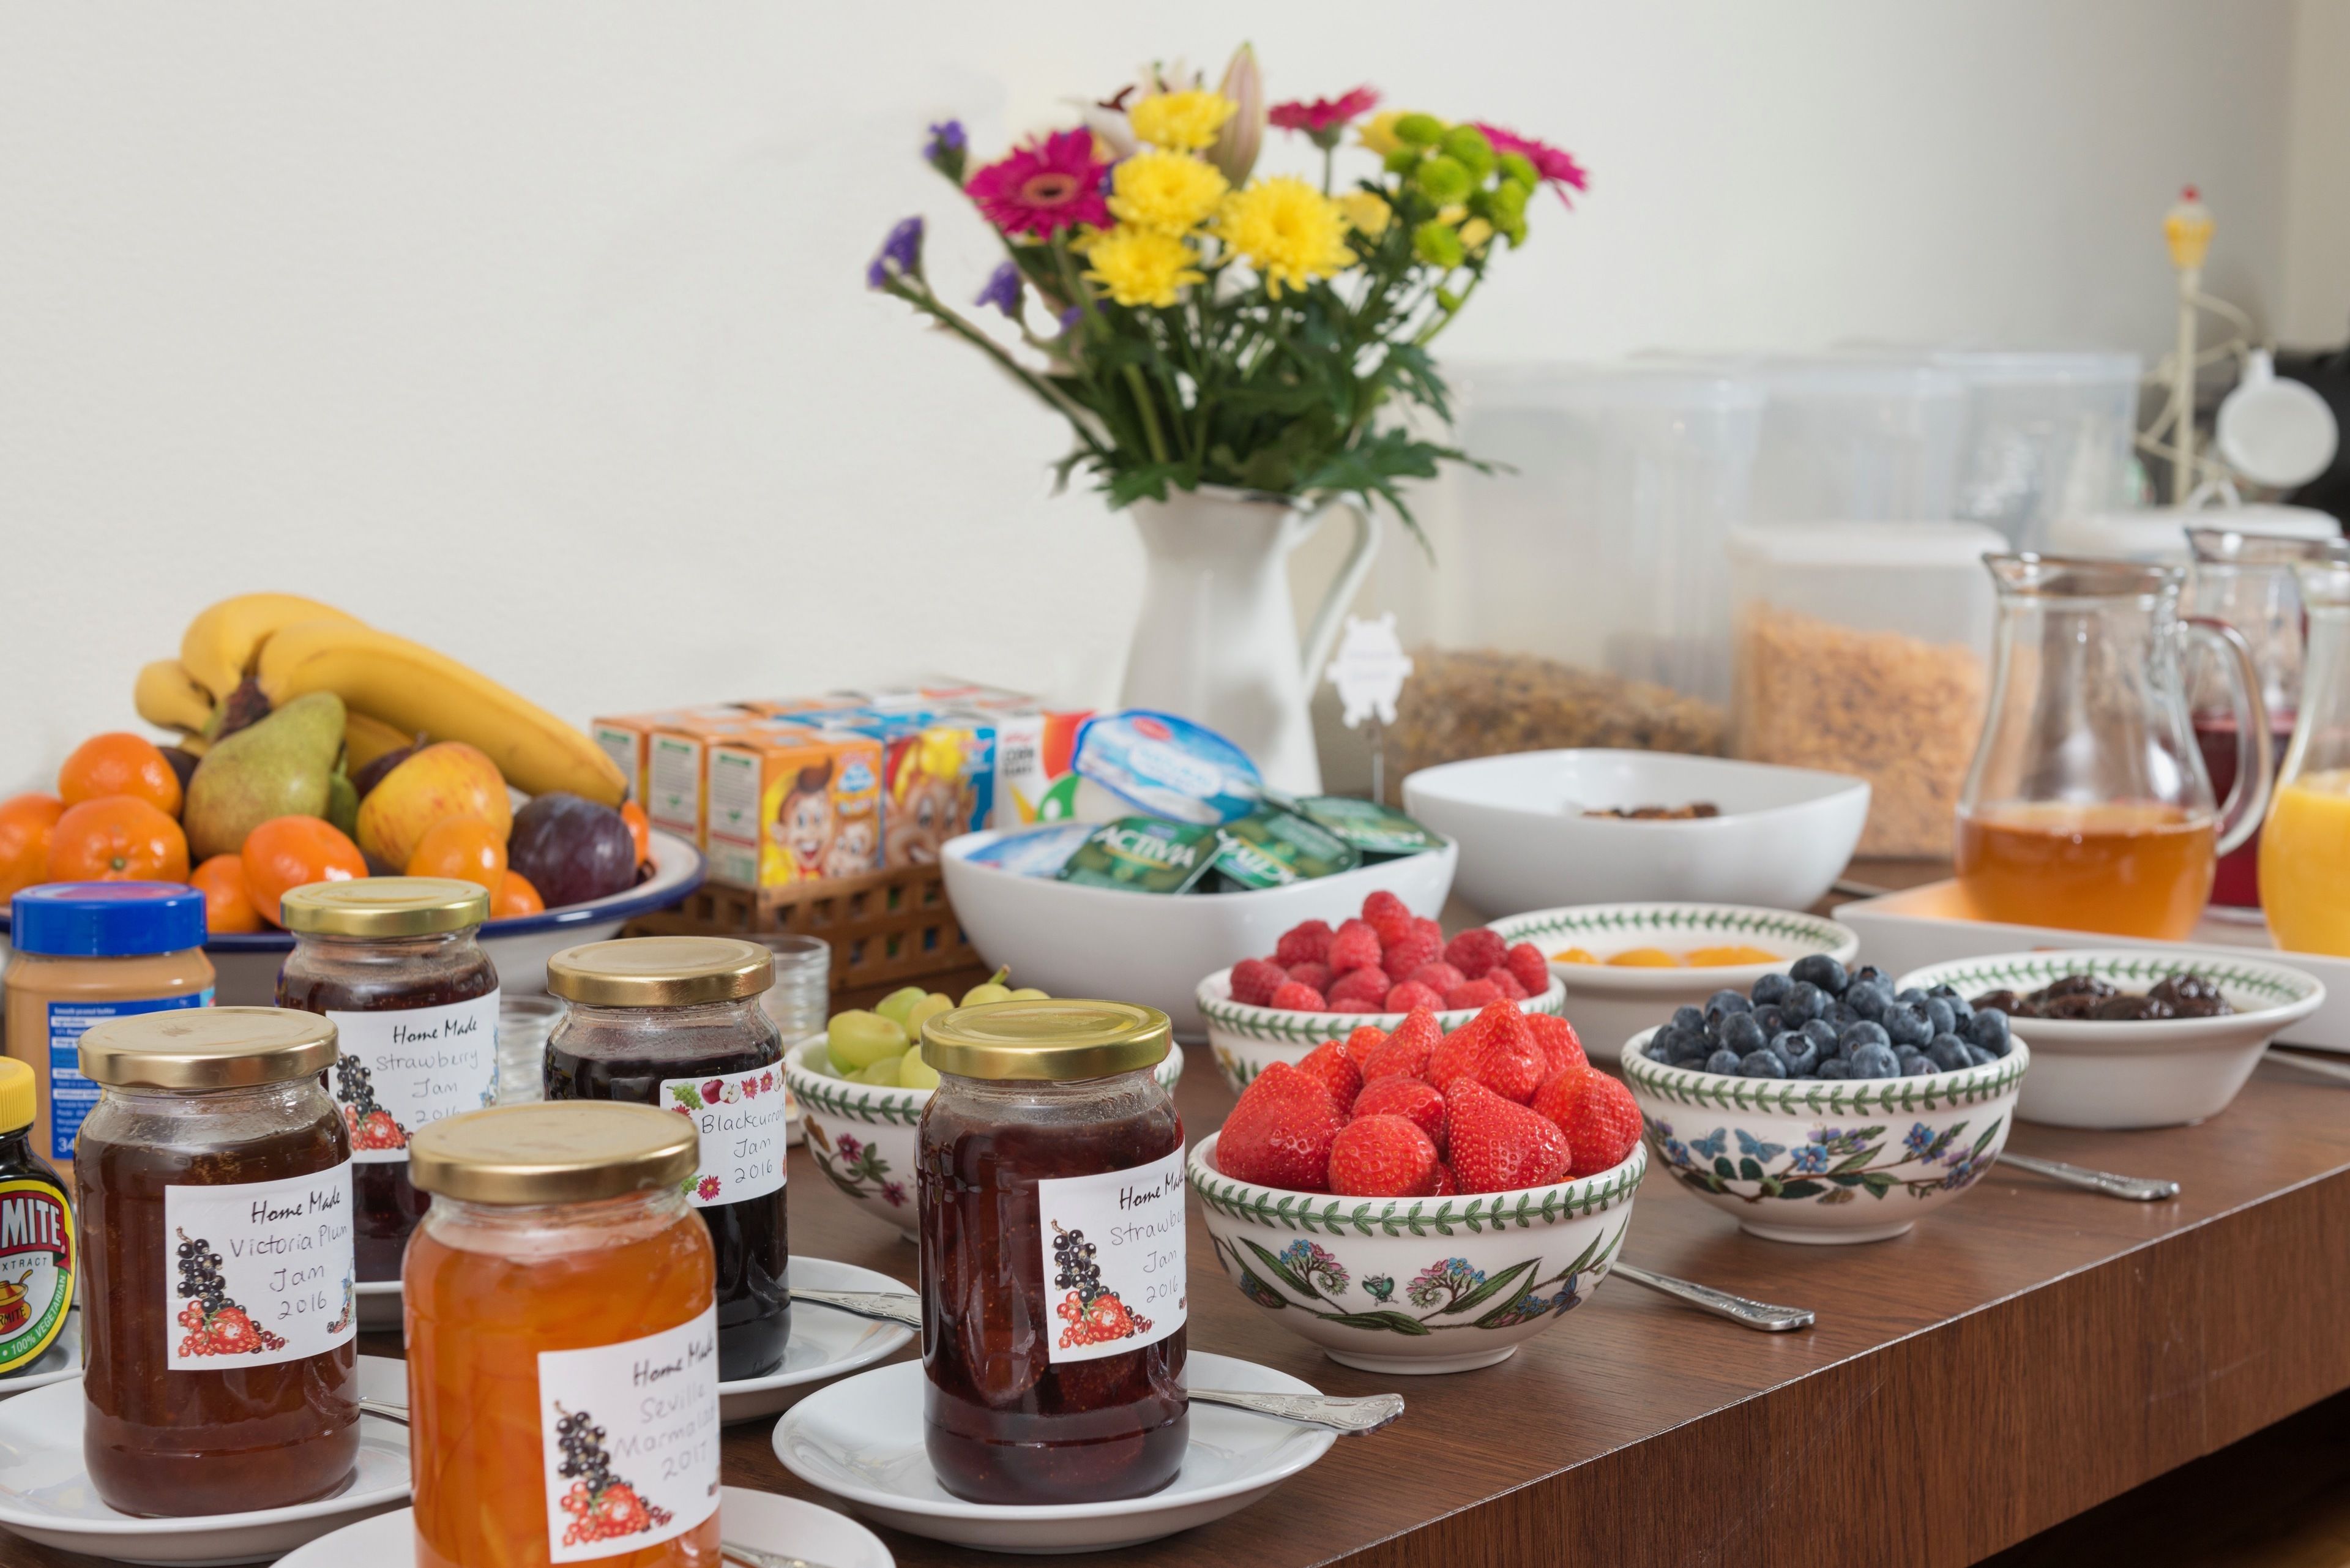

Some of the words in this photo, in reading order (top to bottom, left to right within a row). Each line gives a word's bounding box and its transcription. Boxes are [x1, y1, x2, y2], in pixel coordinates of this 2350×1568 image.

[392, 1025, 438, 1045] Home
[444, 1014, 477, 1038] Made
[376, 1050, 479, 1071] Strawberry
[411, 1078, 458, 1098] Jam
[733, 1138, 771, 1158] Jam
[734, 1159, 773, 1184] 2016
[251, 1200, 304, 1225] Home
[308, 1184, 341, 1214] Made
[1119, 1185, 1161, 1211] Home
[229, 1233, 313, 1258] Victoria
[1143, 1249, 1177, 1274] Jam
[269, 1265, 325, 1293] Jam
[1146, 1275, 1179, 1304] 2016
[11, 1334, 36, 1355] 100%
[35, 1275, 66, 1337] VEGETARIAN
[277, 1290, 327, 1320] 2016
[633, 1357, 684, 1387] Home
